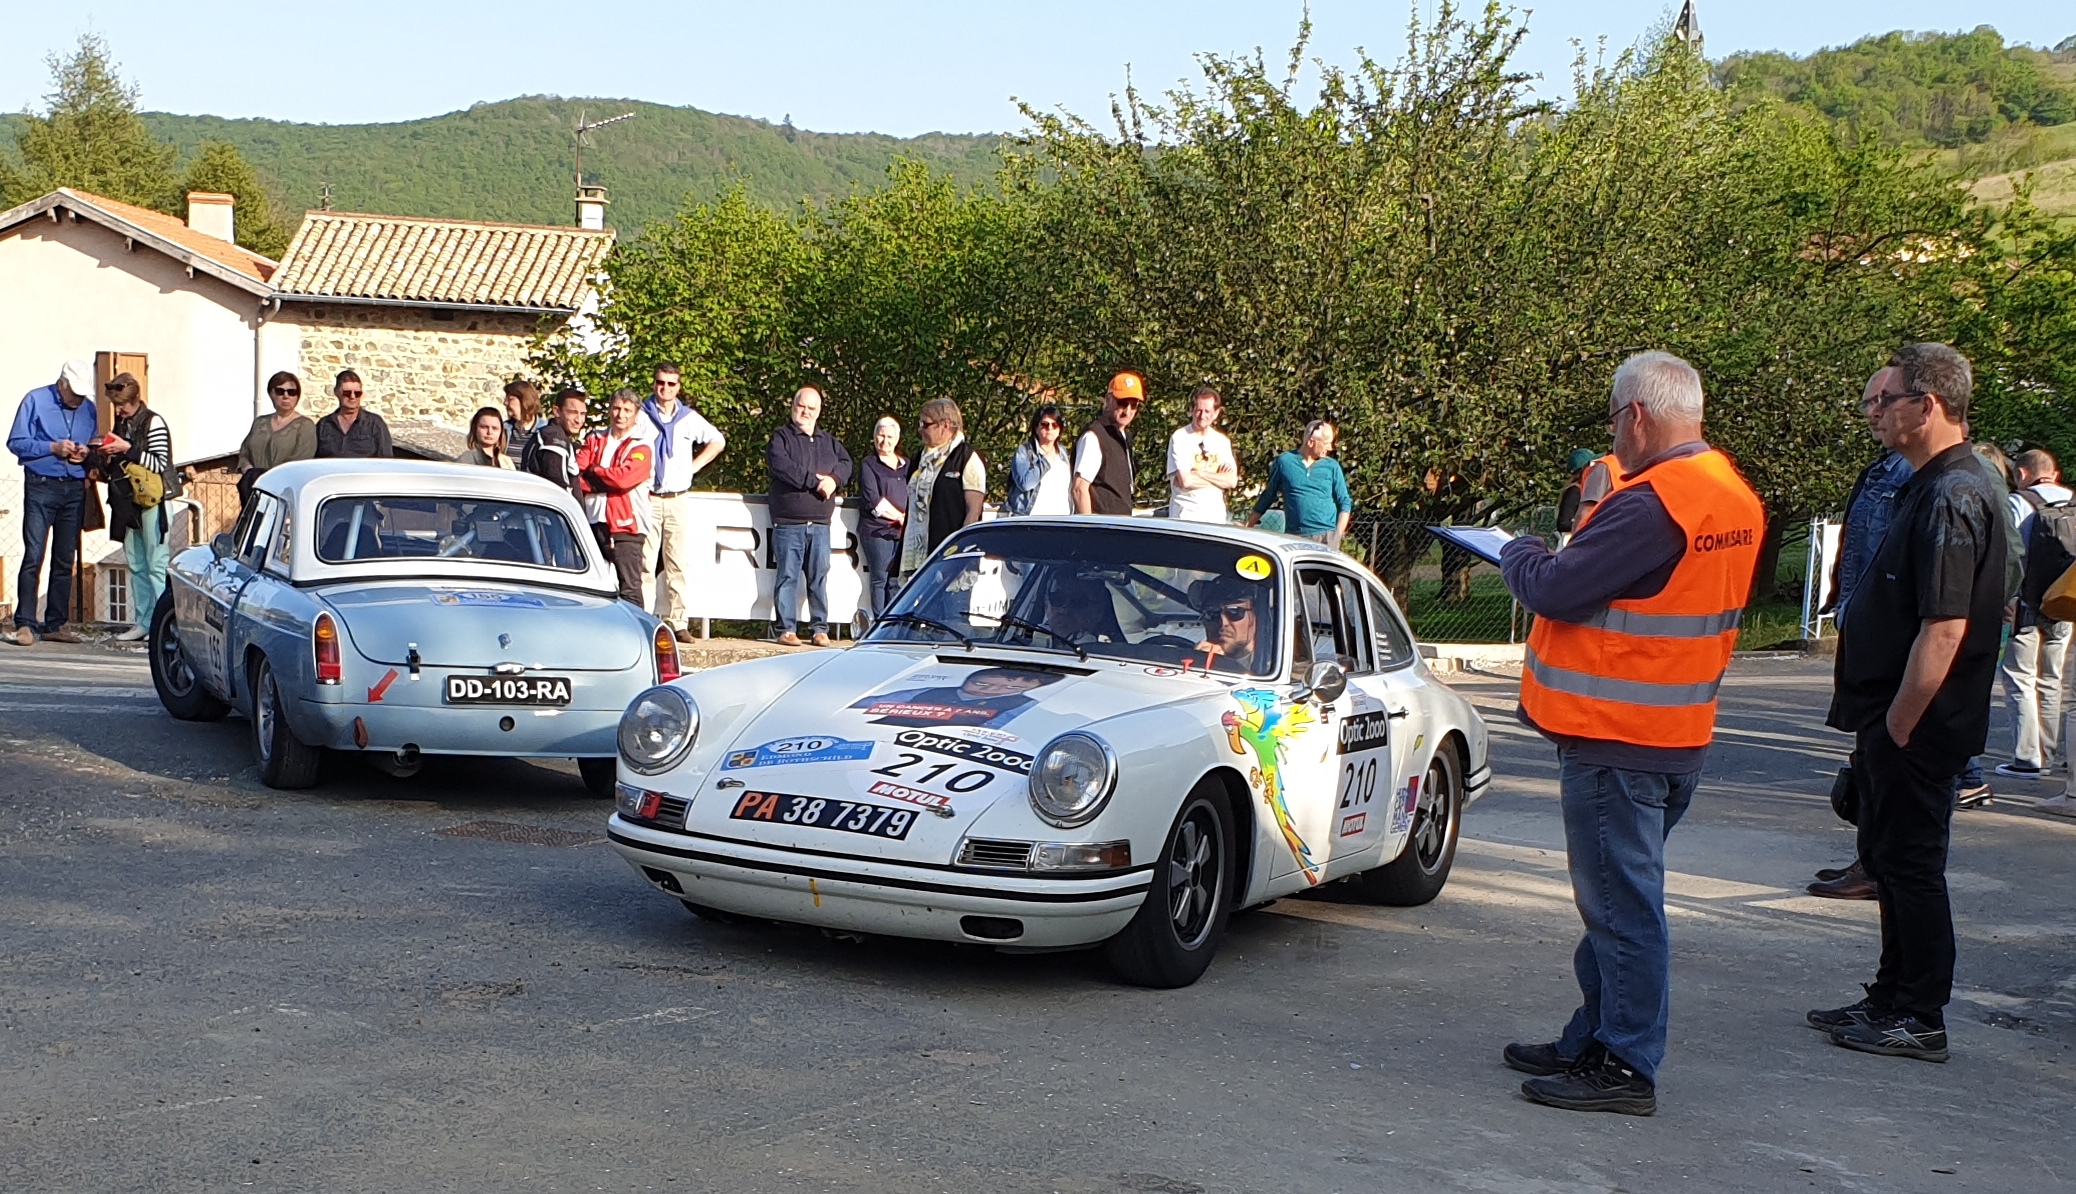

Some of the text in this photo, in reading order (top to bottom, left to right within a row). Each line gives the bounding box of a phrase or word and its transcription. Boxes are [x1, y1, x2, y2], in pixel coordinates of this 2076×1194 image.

[1244, 560, 1260, 573] A
[450, 679, 569, 700] DD-103-RA
[869, 707, 933, 717] SÉRIEUX
[899, 731, 967, 753] Optic
[1339, 715, 1386, 750] Optic 2000
[761, 752, 812, 760] EDMOND
[777, 740, 822, 752] 210
[780, 755, 853, 765] ROTHSCHILD
[870, 753, 995, 793] 210
[1339, 757, 1377, 809] 210
[872, 783, 945, 807] MOTUL
[734, 792, 912, 837] PA 38 7379
